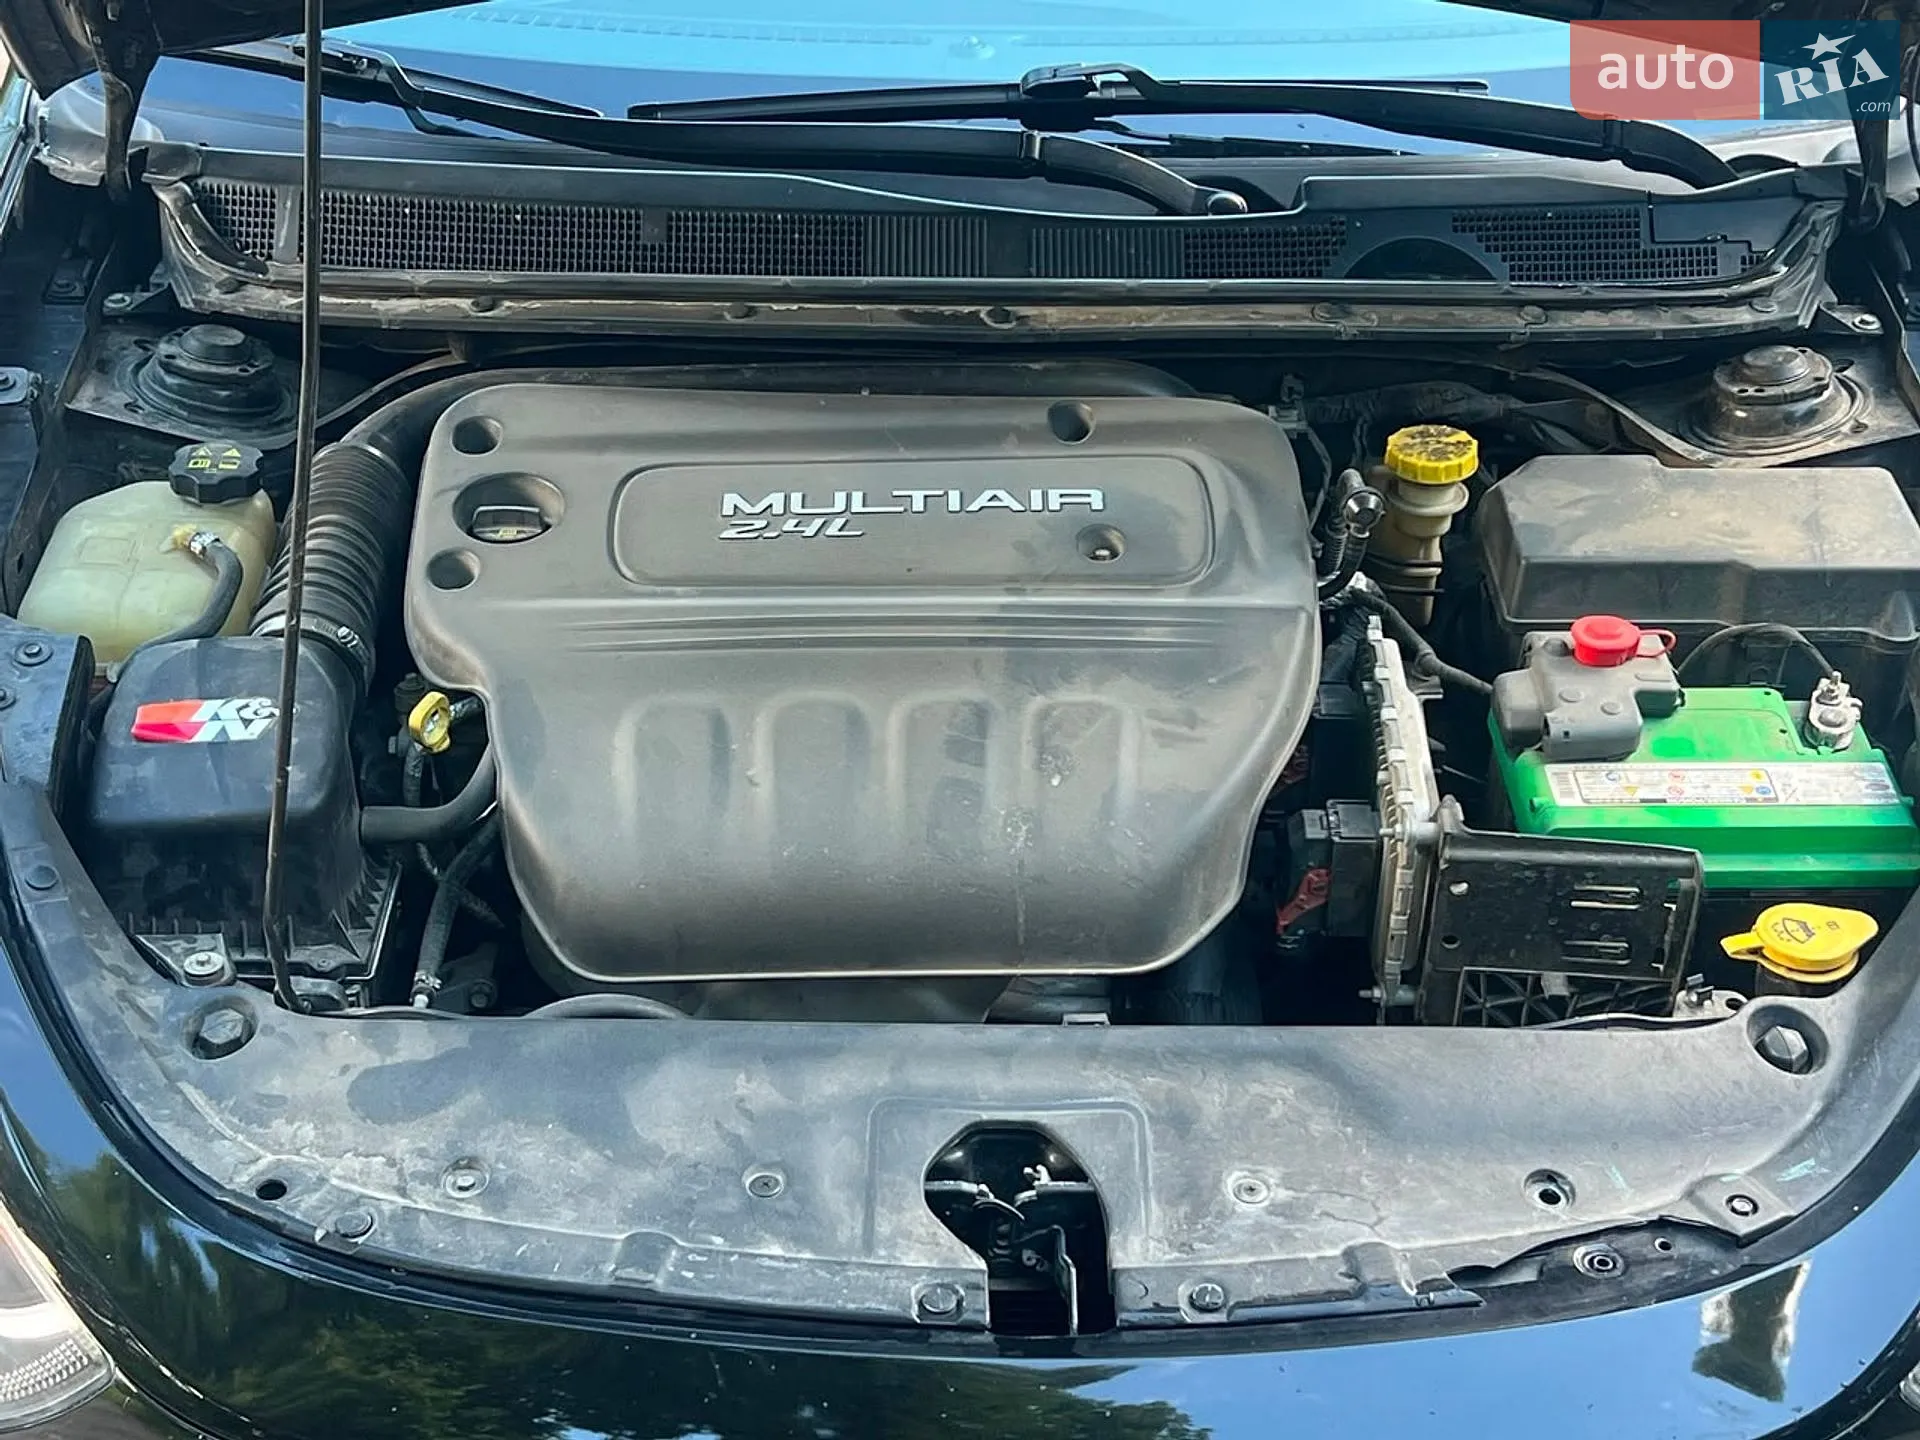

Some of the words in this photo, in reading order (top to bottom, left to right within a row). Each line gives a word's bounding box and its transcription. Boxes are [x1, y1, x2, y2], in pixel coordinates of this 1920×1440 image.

[720, 488, 1106, 517] MULTIAIR
[717, 517, 865, 541] 2.4L
[189, 696, 281, 743] K&N
